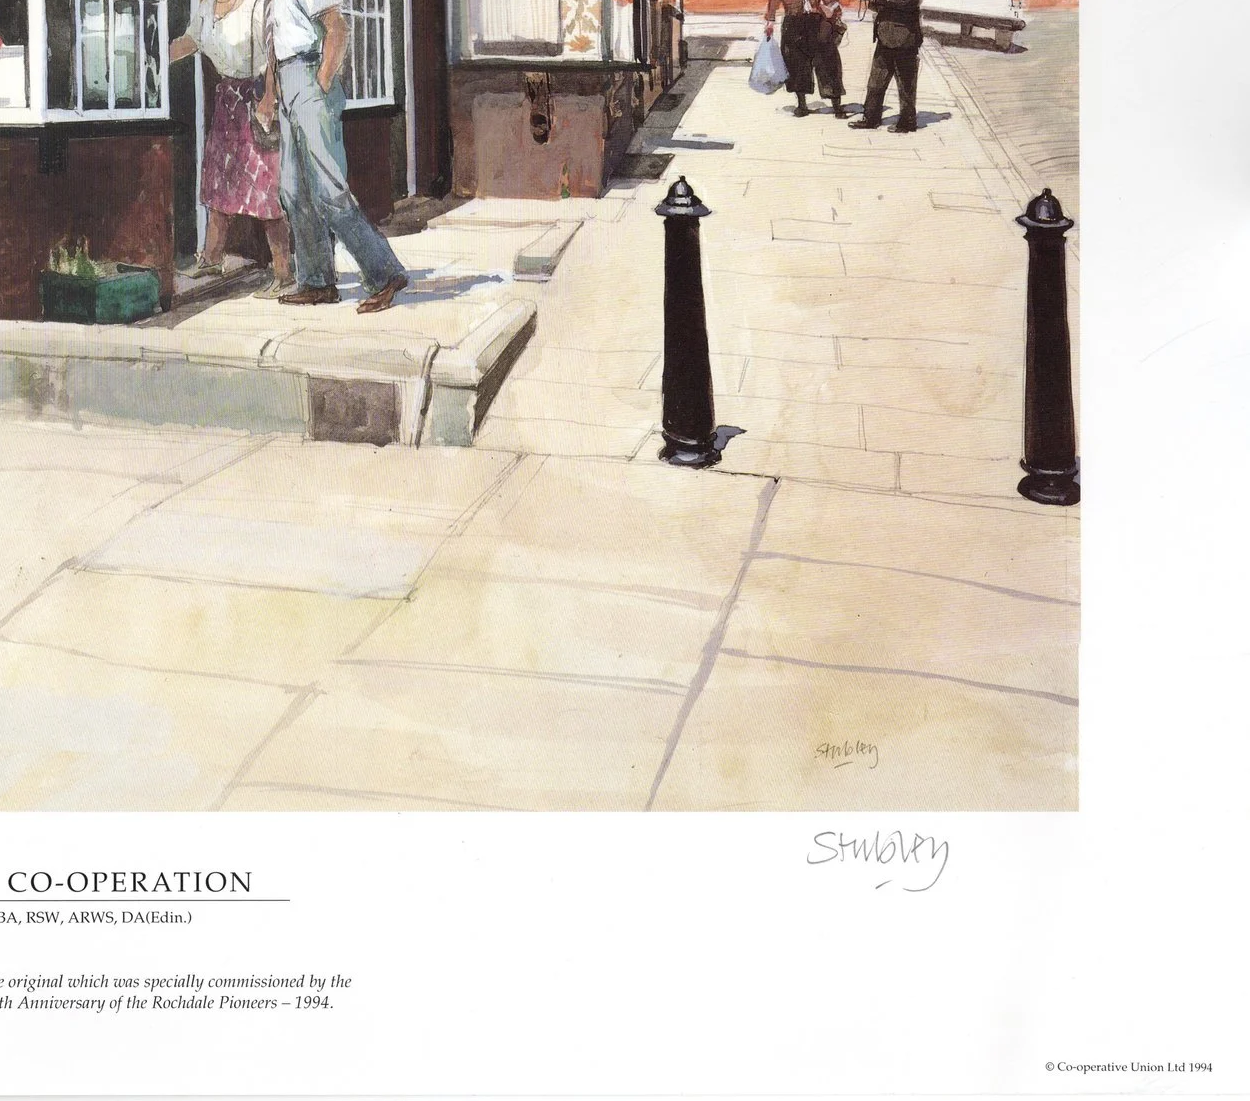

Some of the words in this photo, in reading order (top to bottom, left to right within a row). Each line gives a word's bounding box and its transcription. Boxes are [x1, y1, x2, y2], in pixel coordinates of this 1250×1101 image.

[7, 871, 252, 893] CO-OPERATION
[26, 910, 64, 928] RSW,
[67, 910, 118, 928] ARWS,
[121, 909, 193, 928] DA(Edin.)
[7, 973, 64, 993] original
[67, 974, 109, 989] which
[113, 978, 140, 989] was
[143, 973, 205, 993] specially
[207, 973, 306, 988] commissioned
[309, 973, 327, 993] by
[330, 973, 352, 988] the
[16, 995, 106, 1014] Anniversary
[109, 995, 124, 1014] of
[126, 995, 148, 1010] the
[152, 995, 215, 1010] Rochdale
[219, 995, 278, 1010] Pioneers
[295, 995, 334, 1010] 1994.
[1056, 1061, 1128, 1075] Co-operative
[1130, 1061, 1165, 1072] Union
[1167, 1061, 1186, 1073] Ltd
[1188, 1062, 1213, 1073] 1994
